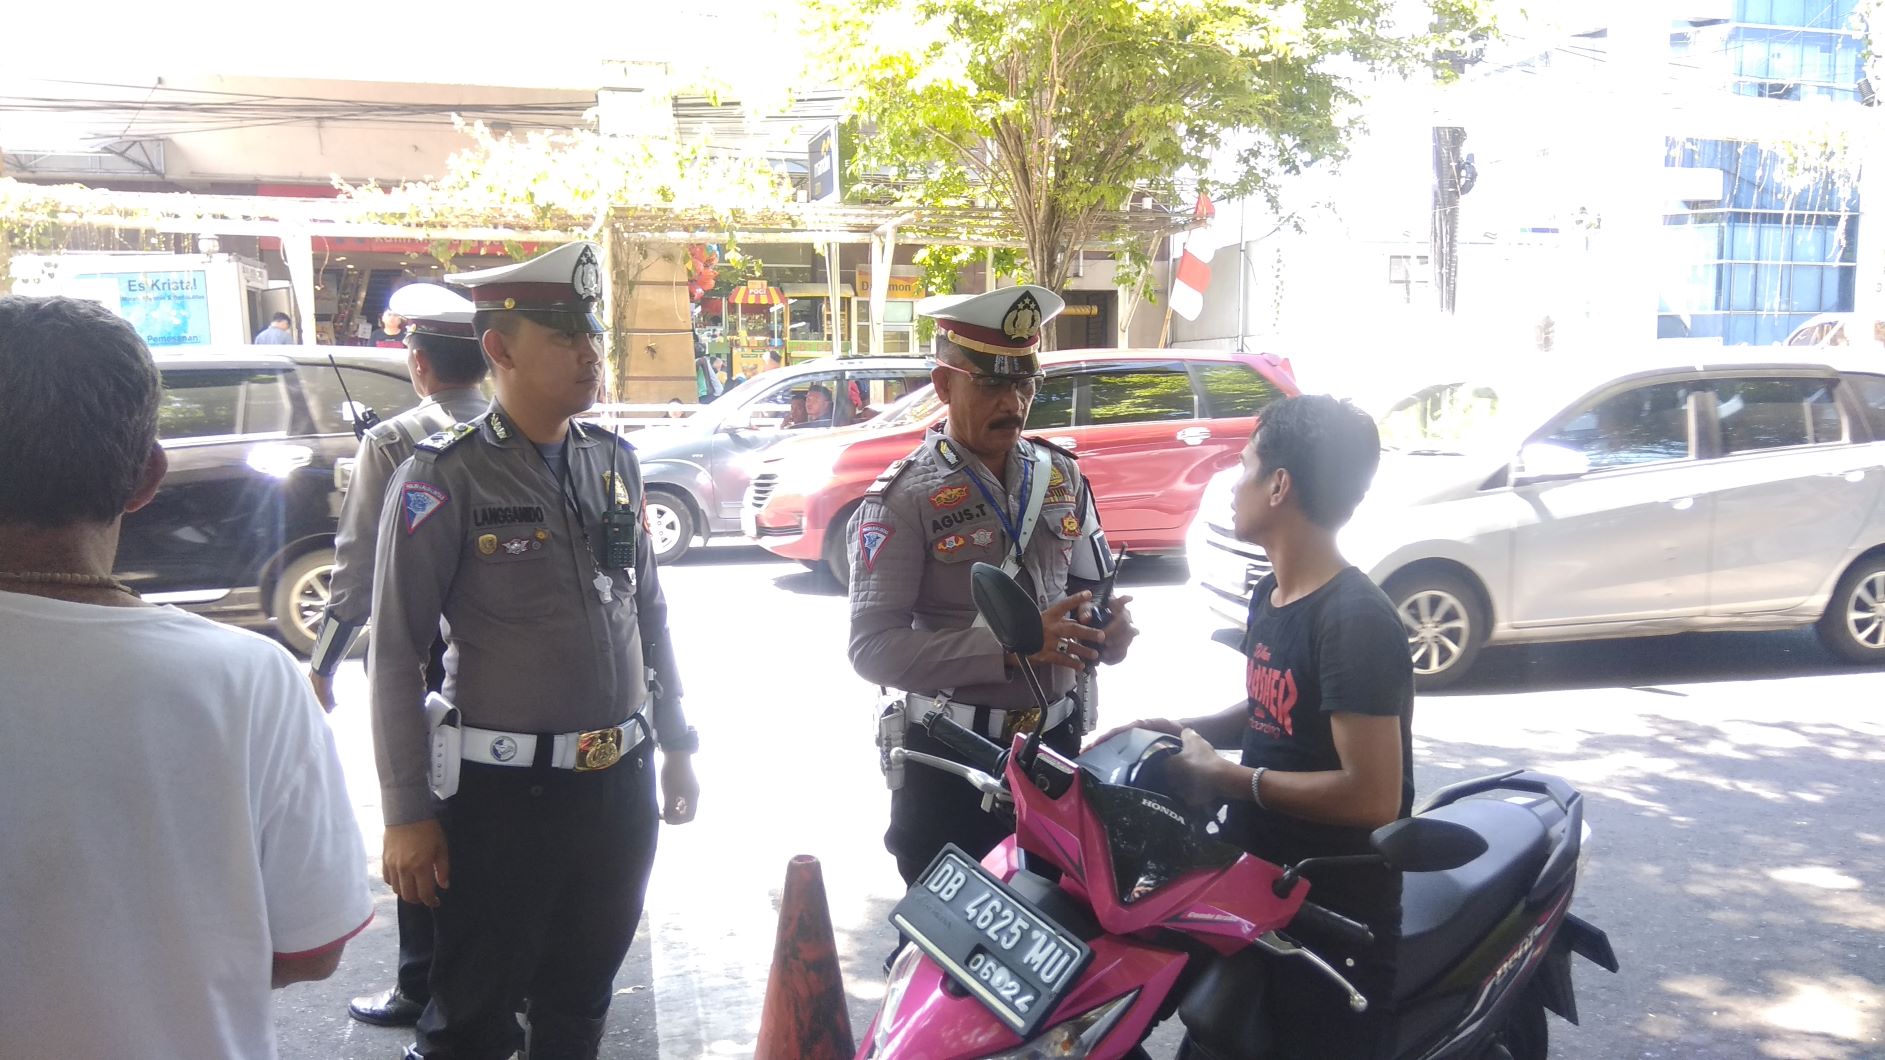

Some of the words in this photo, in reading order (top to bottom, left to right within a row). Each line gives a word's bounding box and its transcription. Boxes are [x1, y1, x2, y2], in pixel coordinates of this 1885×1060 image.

[128, 280, 145, 292] Es
[151, 278, 197, 291] Kristal
[861, 281, 911, 292] Dmon
[1141, 797, 1186, 826] HONDA
[927, 863, 967, 903] DB
[964, 892, 1030, 950] 4625
[1023, 934, 1070, 984] MU
